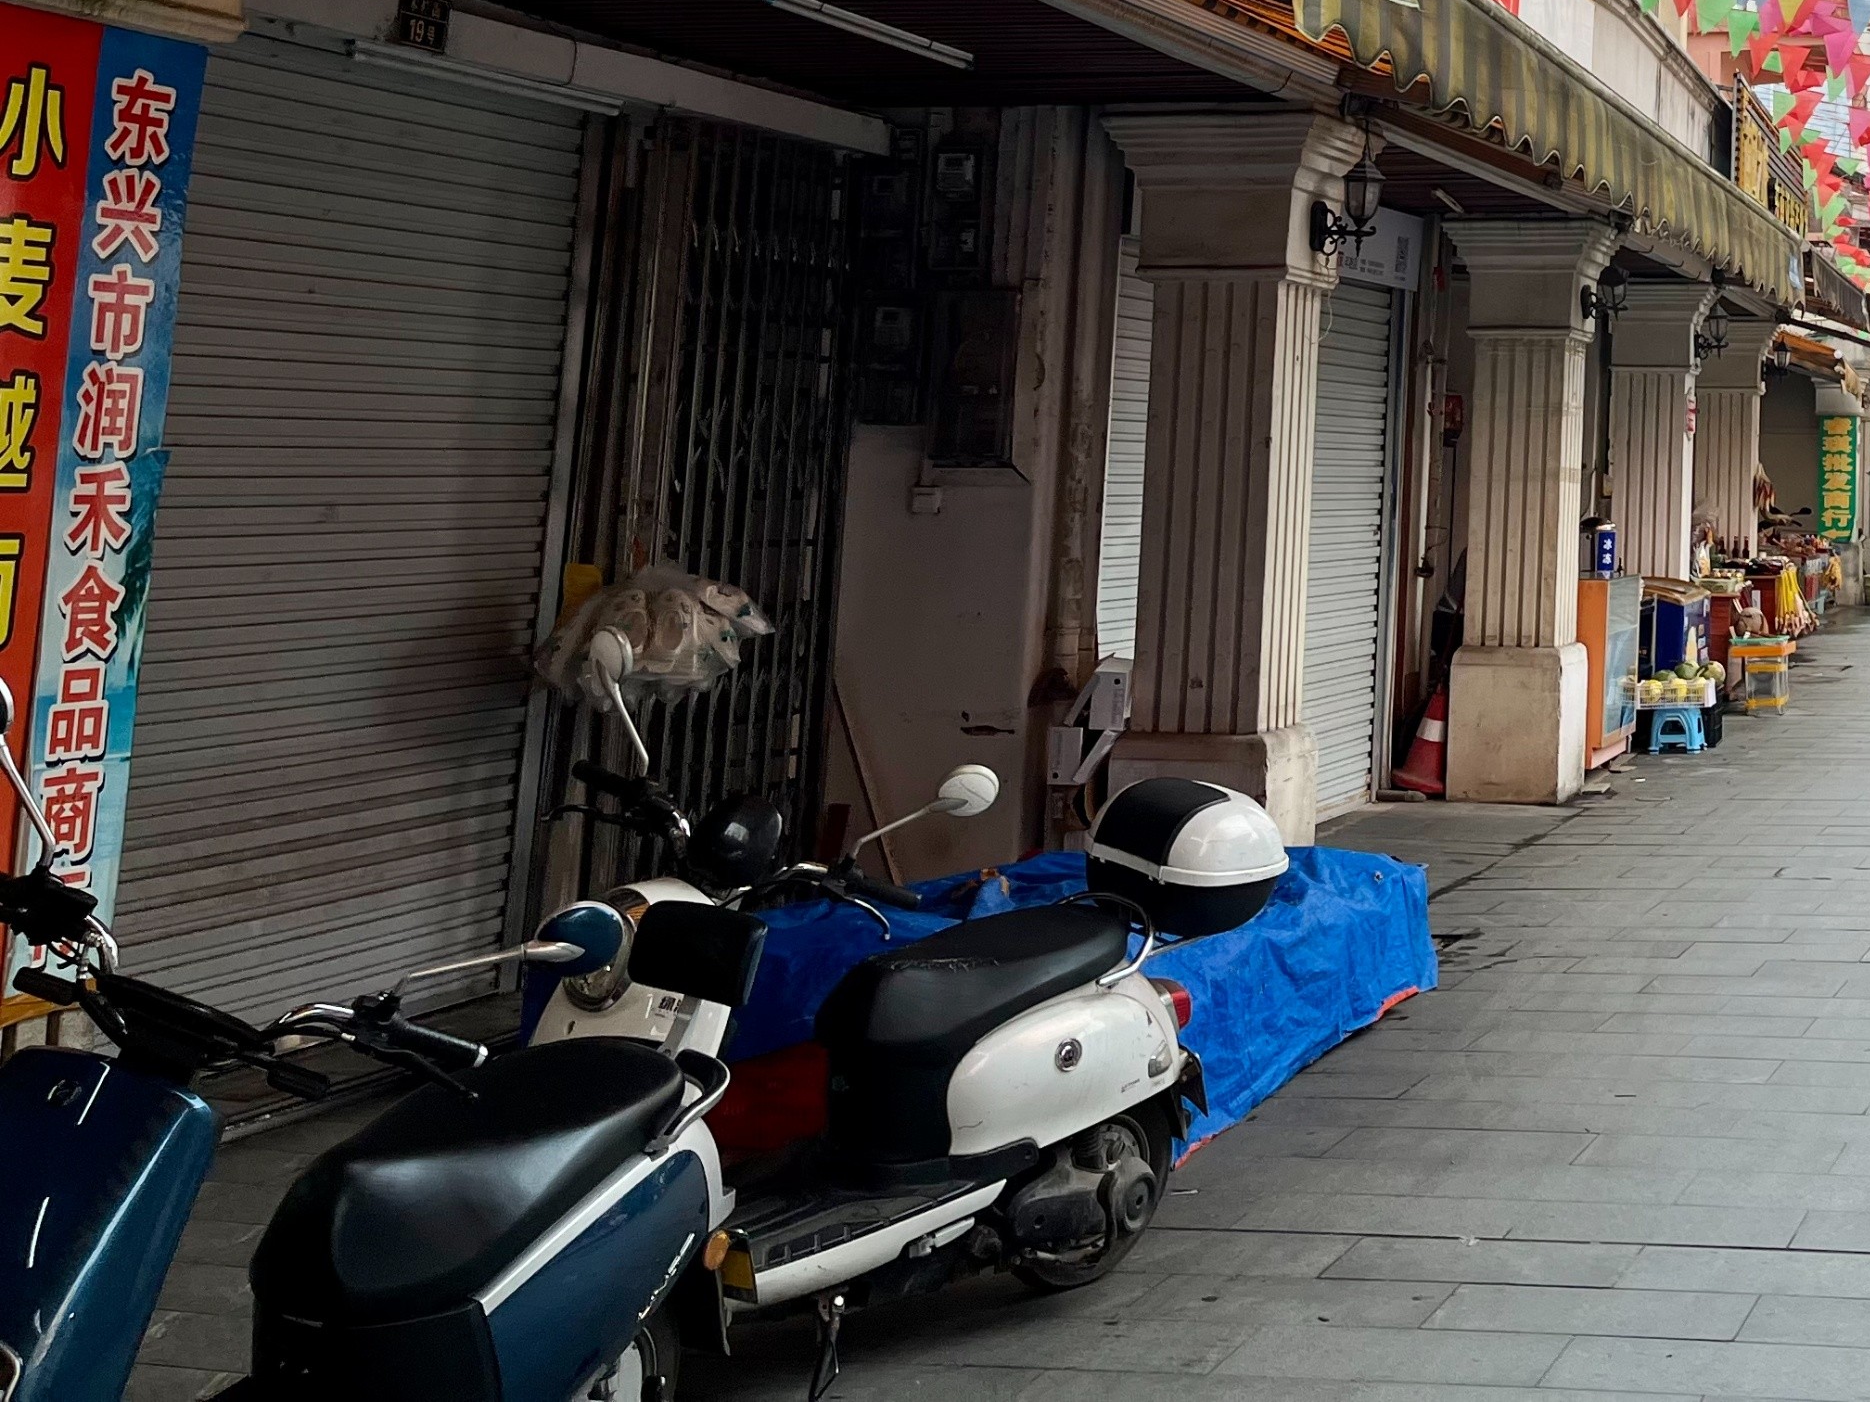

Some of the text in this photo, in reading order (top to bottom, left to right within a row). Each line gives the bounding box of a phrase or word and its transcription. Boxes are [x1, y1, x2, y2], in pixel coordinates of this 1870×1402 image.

[26, 69, 177, 970] 东兴市润禾食品商
